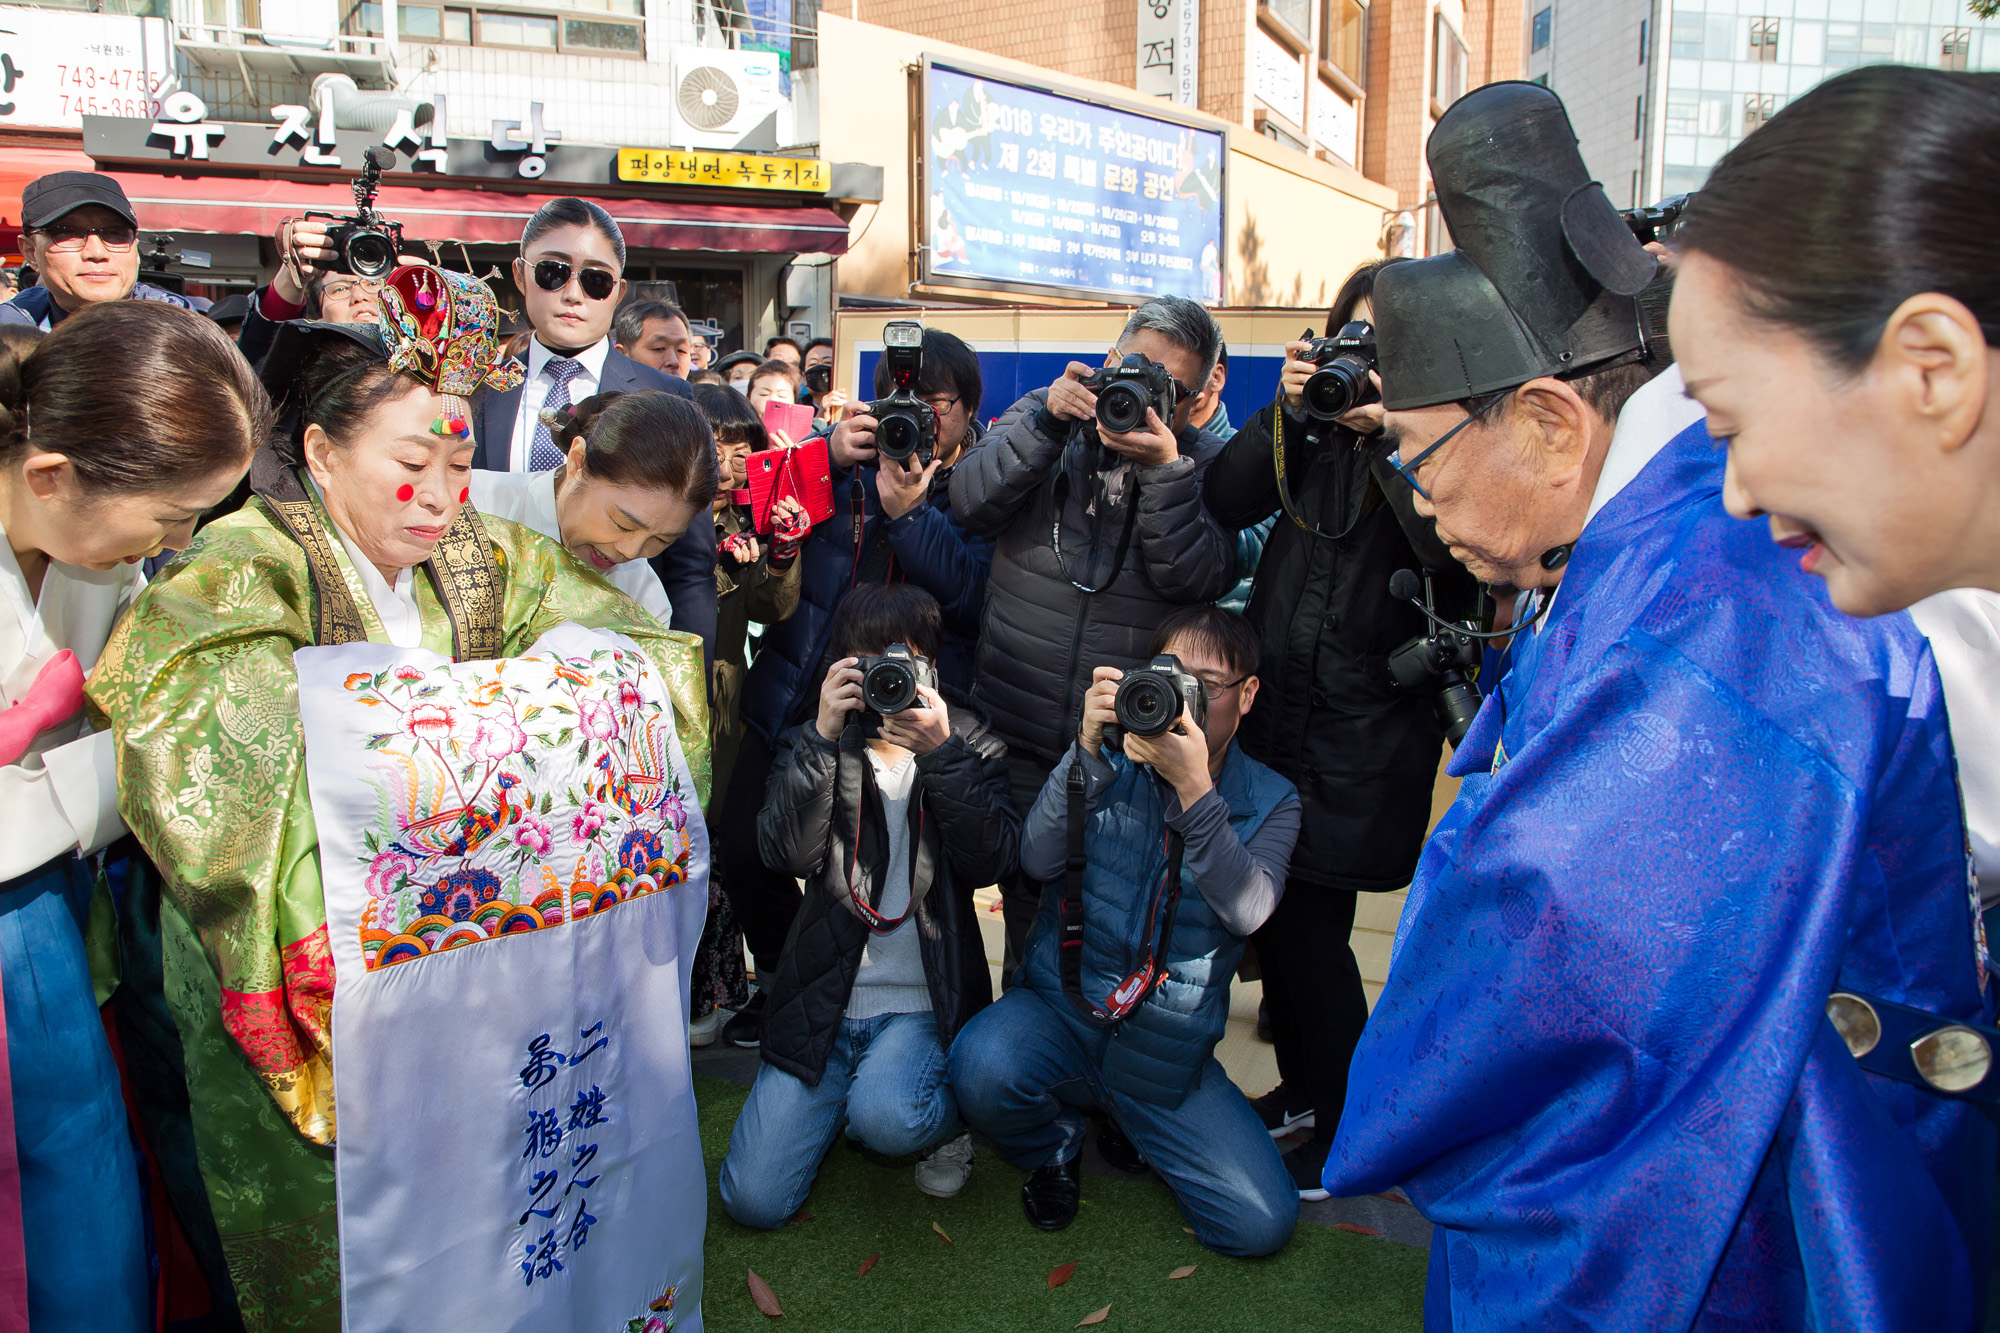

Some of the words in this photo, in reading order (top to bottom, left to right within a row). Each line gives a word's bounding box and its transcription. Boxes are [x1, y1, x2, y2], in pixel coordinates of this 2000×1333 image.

[57, 65, 160, 93] 743-4755
[60, 95, 162, 118] 745-3682
[992, 101, 1032, 138] 2018
[1039, 112, 1091, 150] 우리가
[149, 88, 562, 179] 유진식당
[998, 141, 1018, 174] 제
[1026, 146, 1056, 180] 2회
[1063, 153, 1096, 187] 특별
[1103, 162, 1137, 194] 문화
[1143, 171, 1174, 202] 공연
[1151, 664, 1173, 672] Canon
